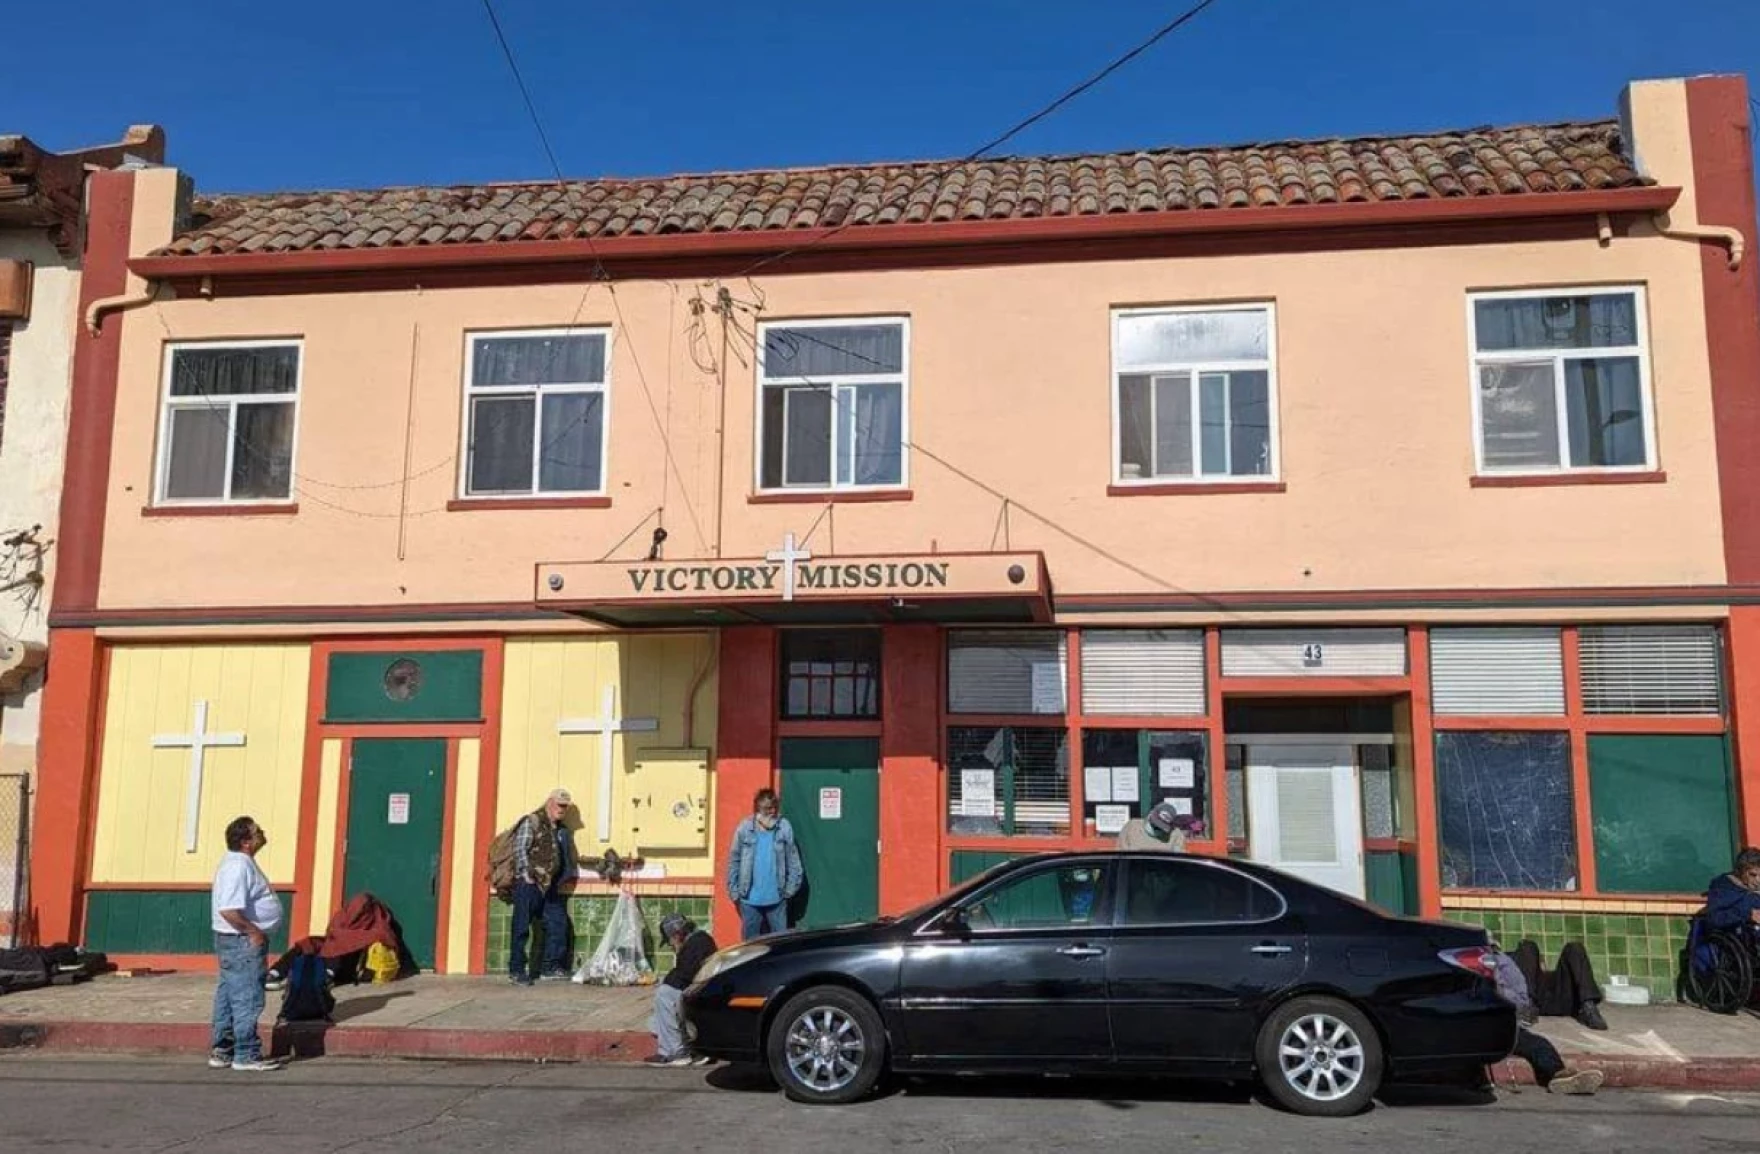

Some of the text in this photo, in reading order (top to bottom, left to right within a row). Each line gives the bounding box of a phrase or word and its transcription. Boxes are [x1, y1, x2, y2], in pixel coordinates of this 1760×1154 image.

[627, 563, 950, 591] VICTORY MISSION
[1304, 644, 1322, 659] 43
